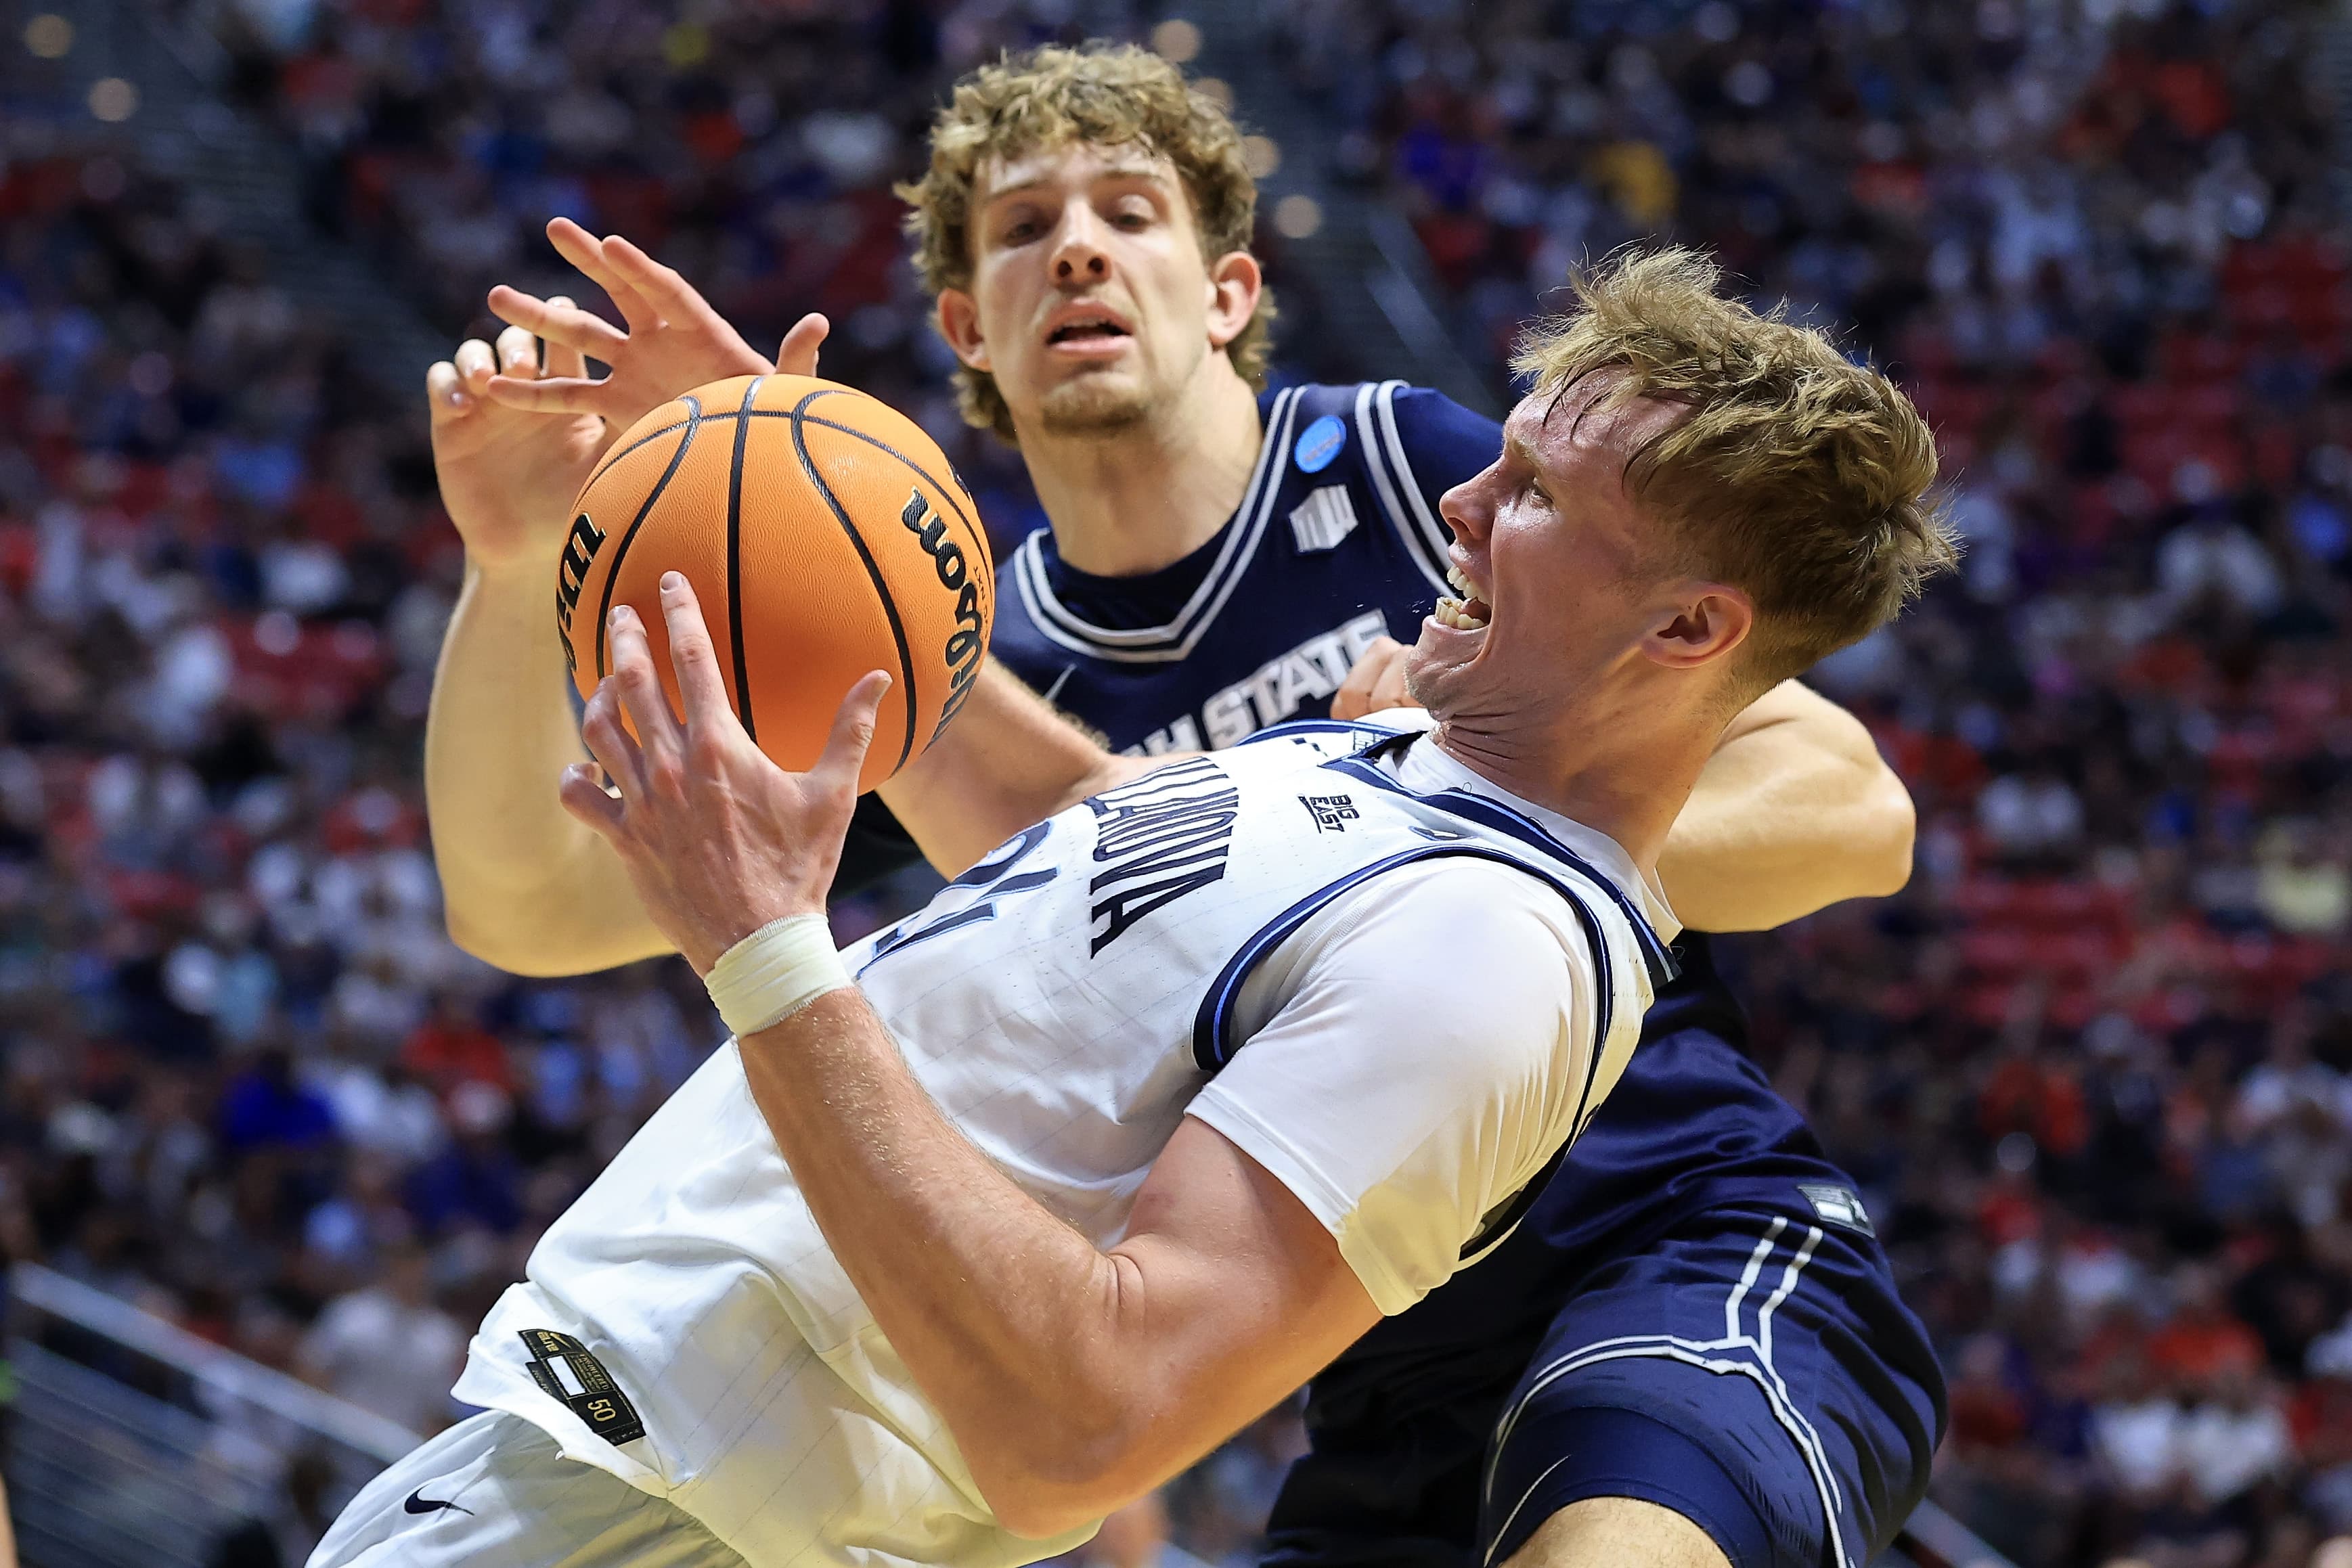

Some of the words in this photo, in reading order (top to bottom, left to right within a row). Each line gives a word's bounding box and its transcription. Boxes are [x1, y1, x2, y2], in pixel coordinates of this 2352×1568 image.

[1309, 797, 1345, 832] EAST
[1329, 794, 1359, 819] BIG
[587, 1398, 616, 1422] 50
